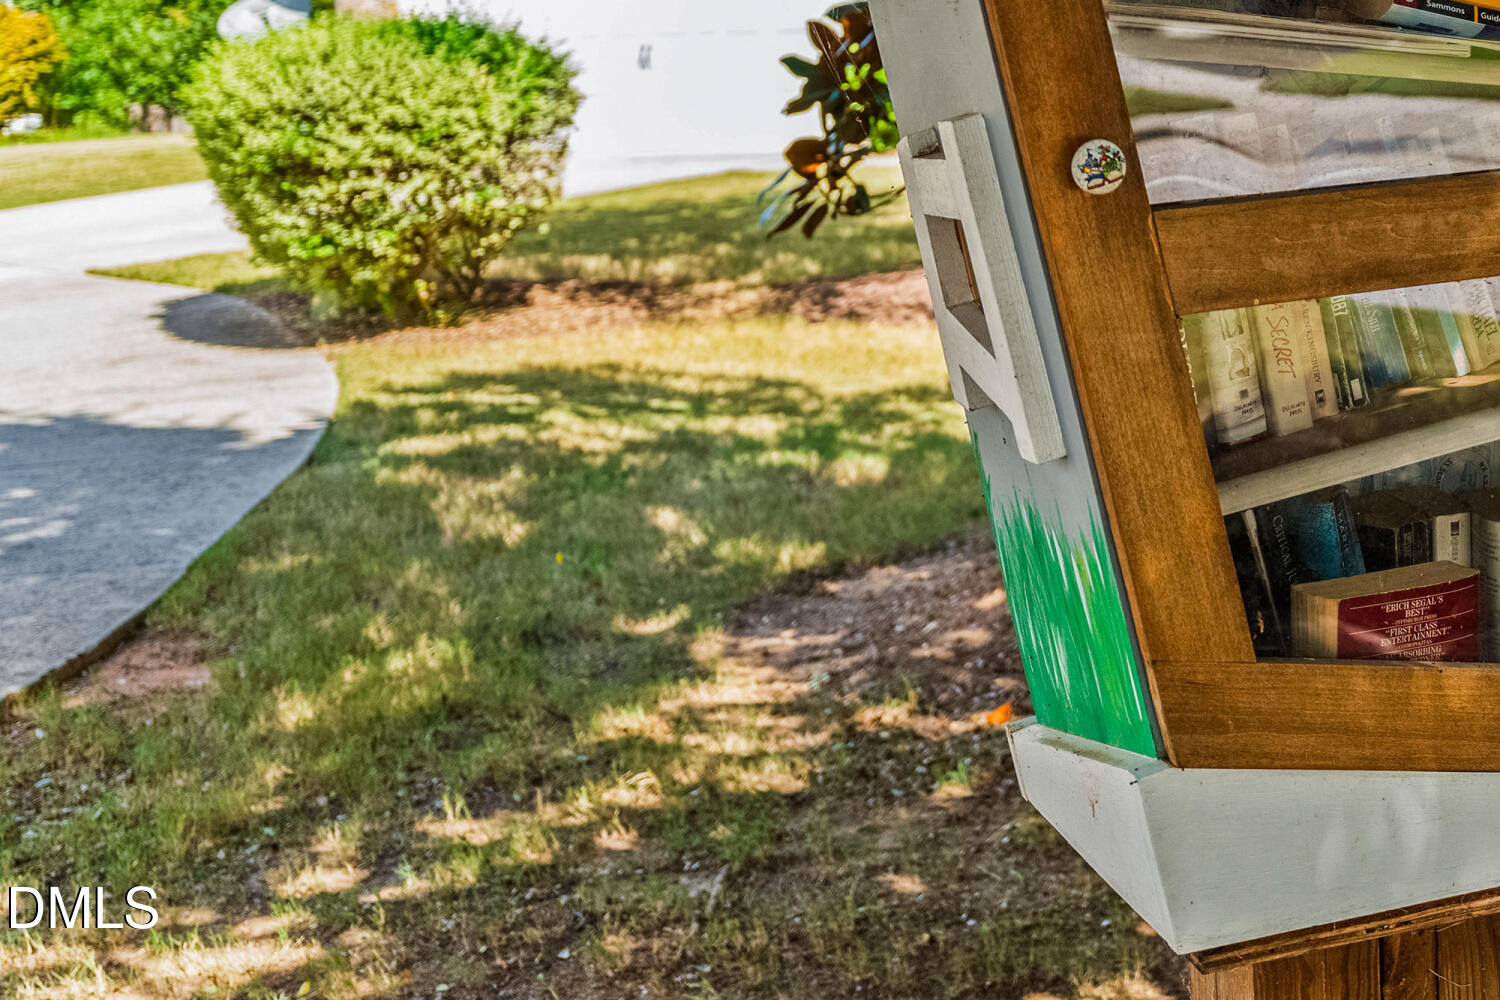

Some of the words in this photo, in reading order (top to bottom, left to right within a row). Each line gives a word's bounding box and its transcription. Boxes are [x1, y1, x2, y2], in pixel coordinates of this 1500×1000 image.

[1426, 0, 1465, 15] Sammons
[1265, 315, 1297, 379] SECRET
[1306, 329, 1322, 385] KINGSBURY
[1272, 515, 1297, 567] CRITICAL
[1413, 621, 1438, 633] CLASS
